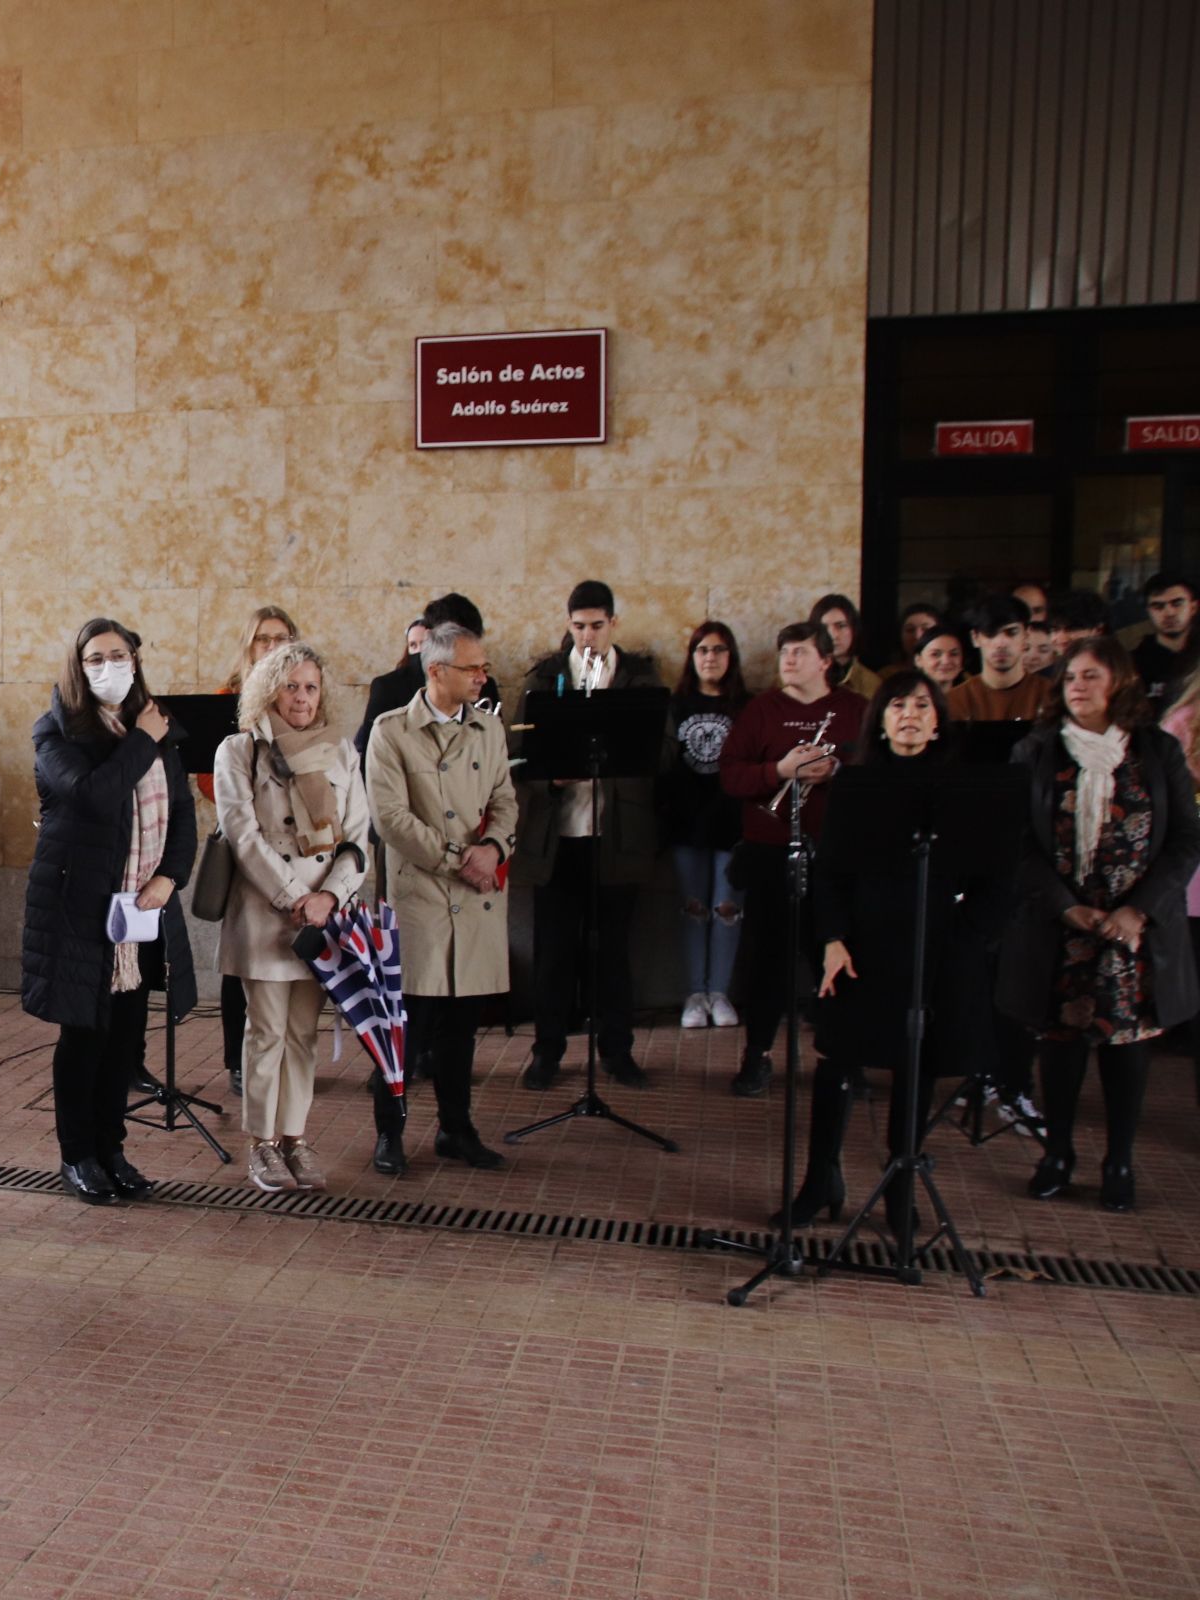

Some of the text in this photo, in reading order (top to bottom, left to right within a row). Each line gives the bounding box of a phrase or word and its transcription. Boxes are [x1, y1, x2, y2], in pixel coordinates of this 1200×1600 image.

[436, 363, 586, 385] Salón de Actos
[451, 398, 569, 417] Adolfo Suárez
[950, 430, 1018, 448] SALIDA
[1141, 424, 1200, 443] SALID
